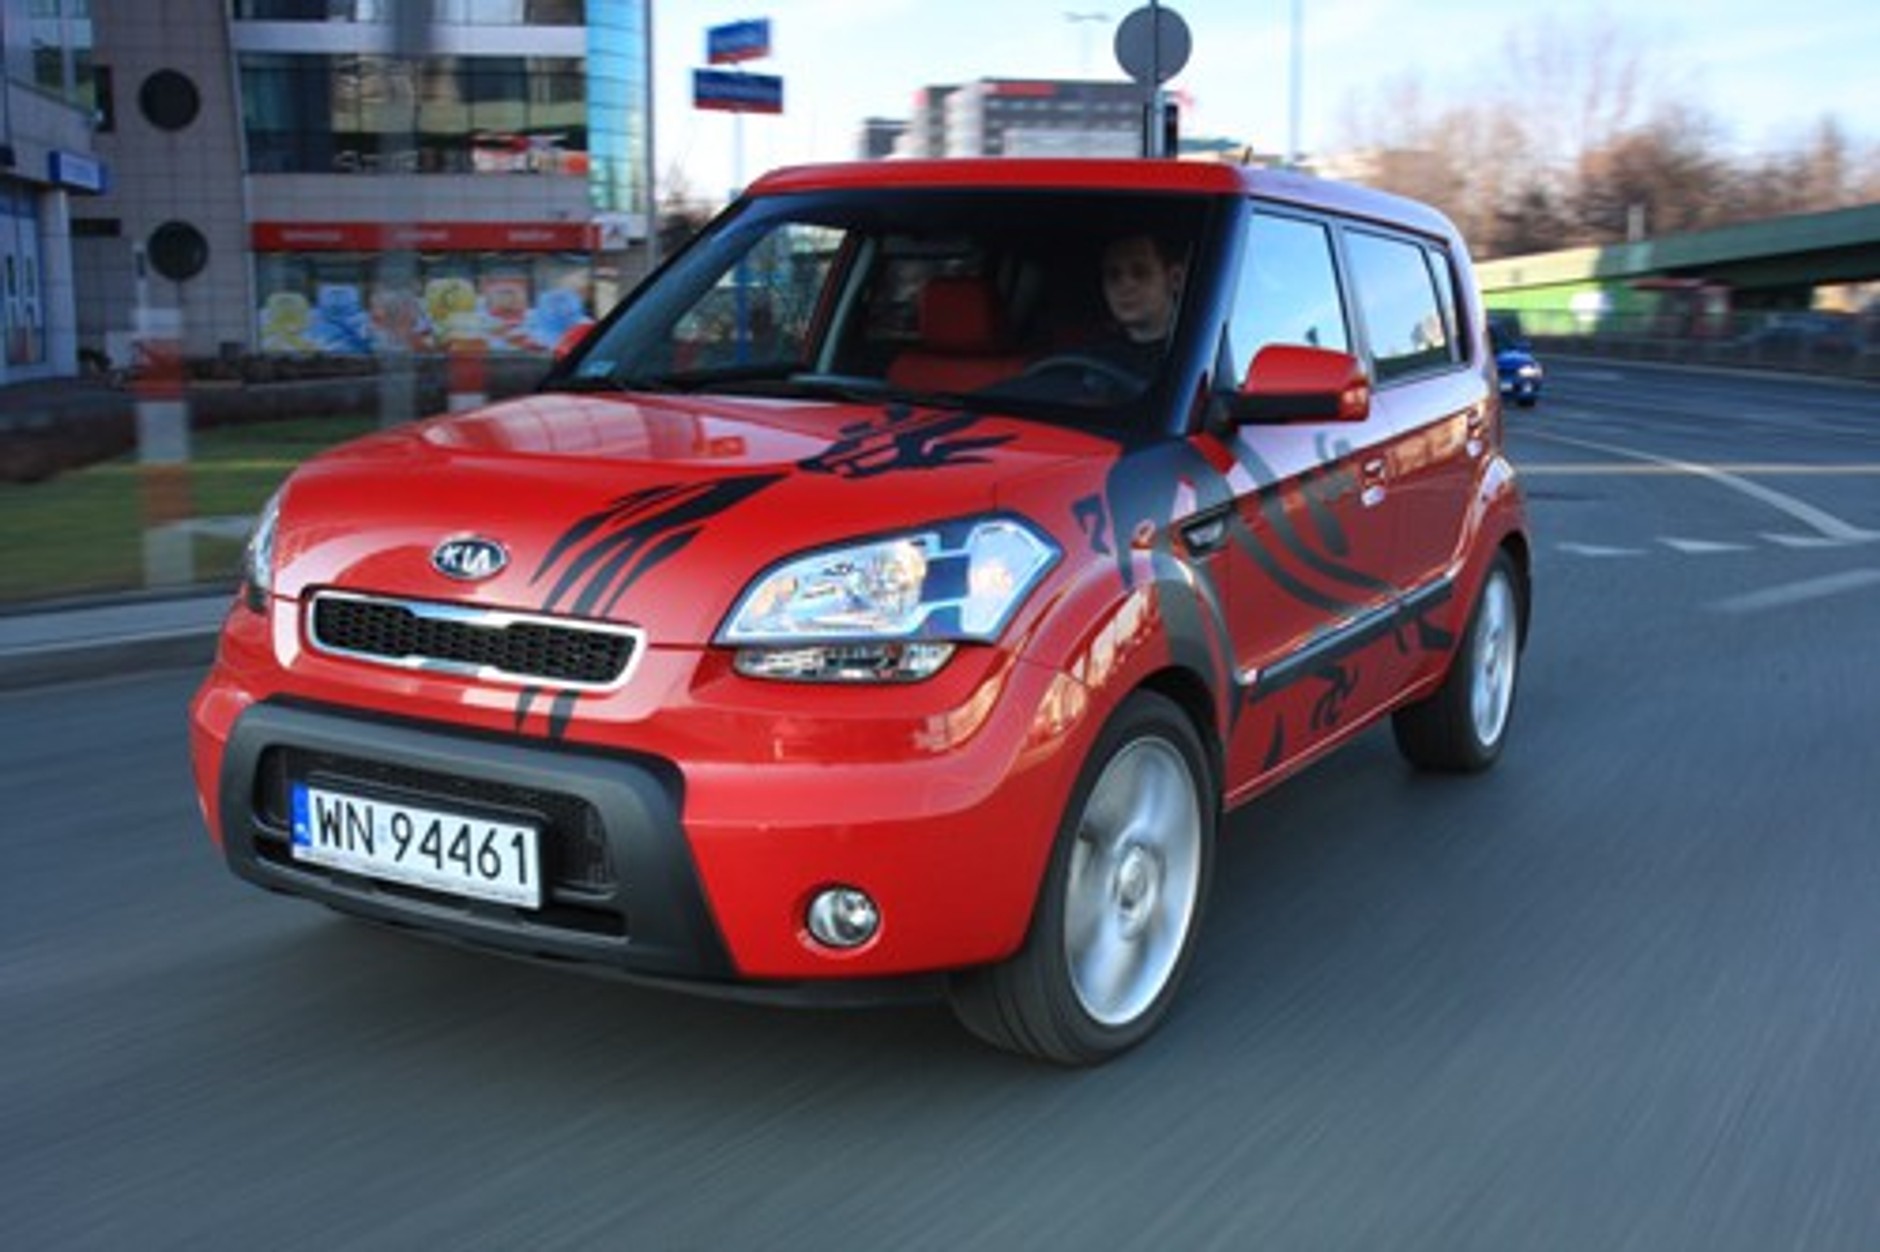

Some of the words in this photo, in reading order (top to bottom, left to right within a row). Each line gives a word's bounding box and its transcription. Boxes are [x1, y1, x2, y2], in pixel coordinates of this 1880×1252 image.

[441, 544, 494, 574] KIA
[315, 796, 374, 856] WN
[390, 811, 528, 885] 94461
